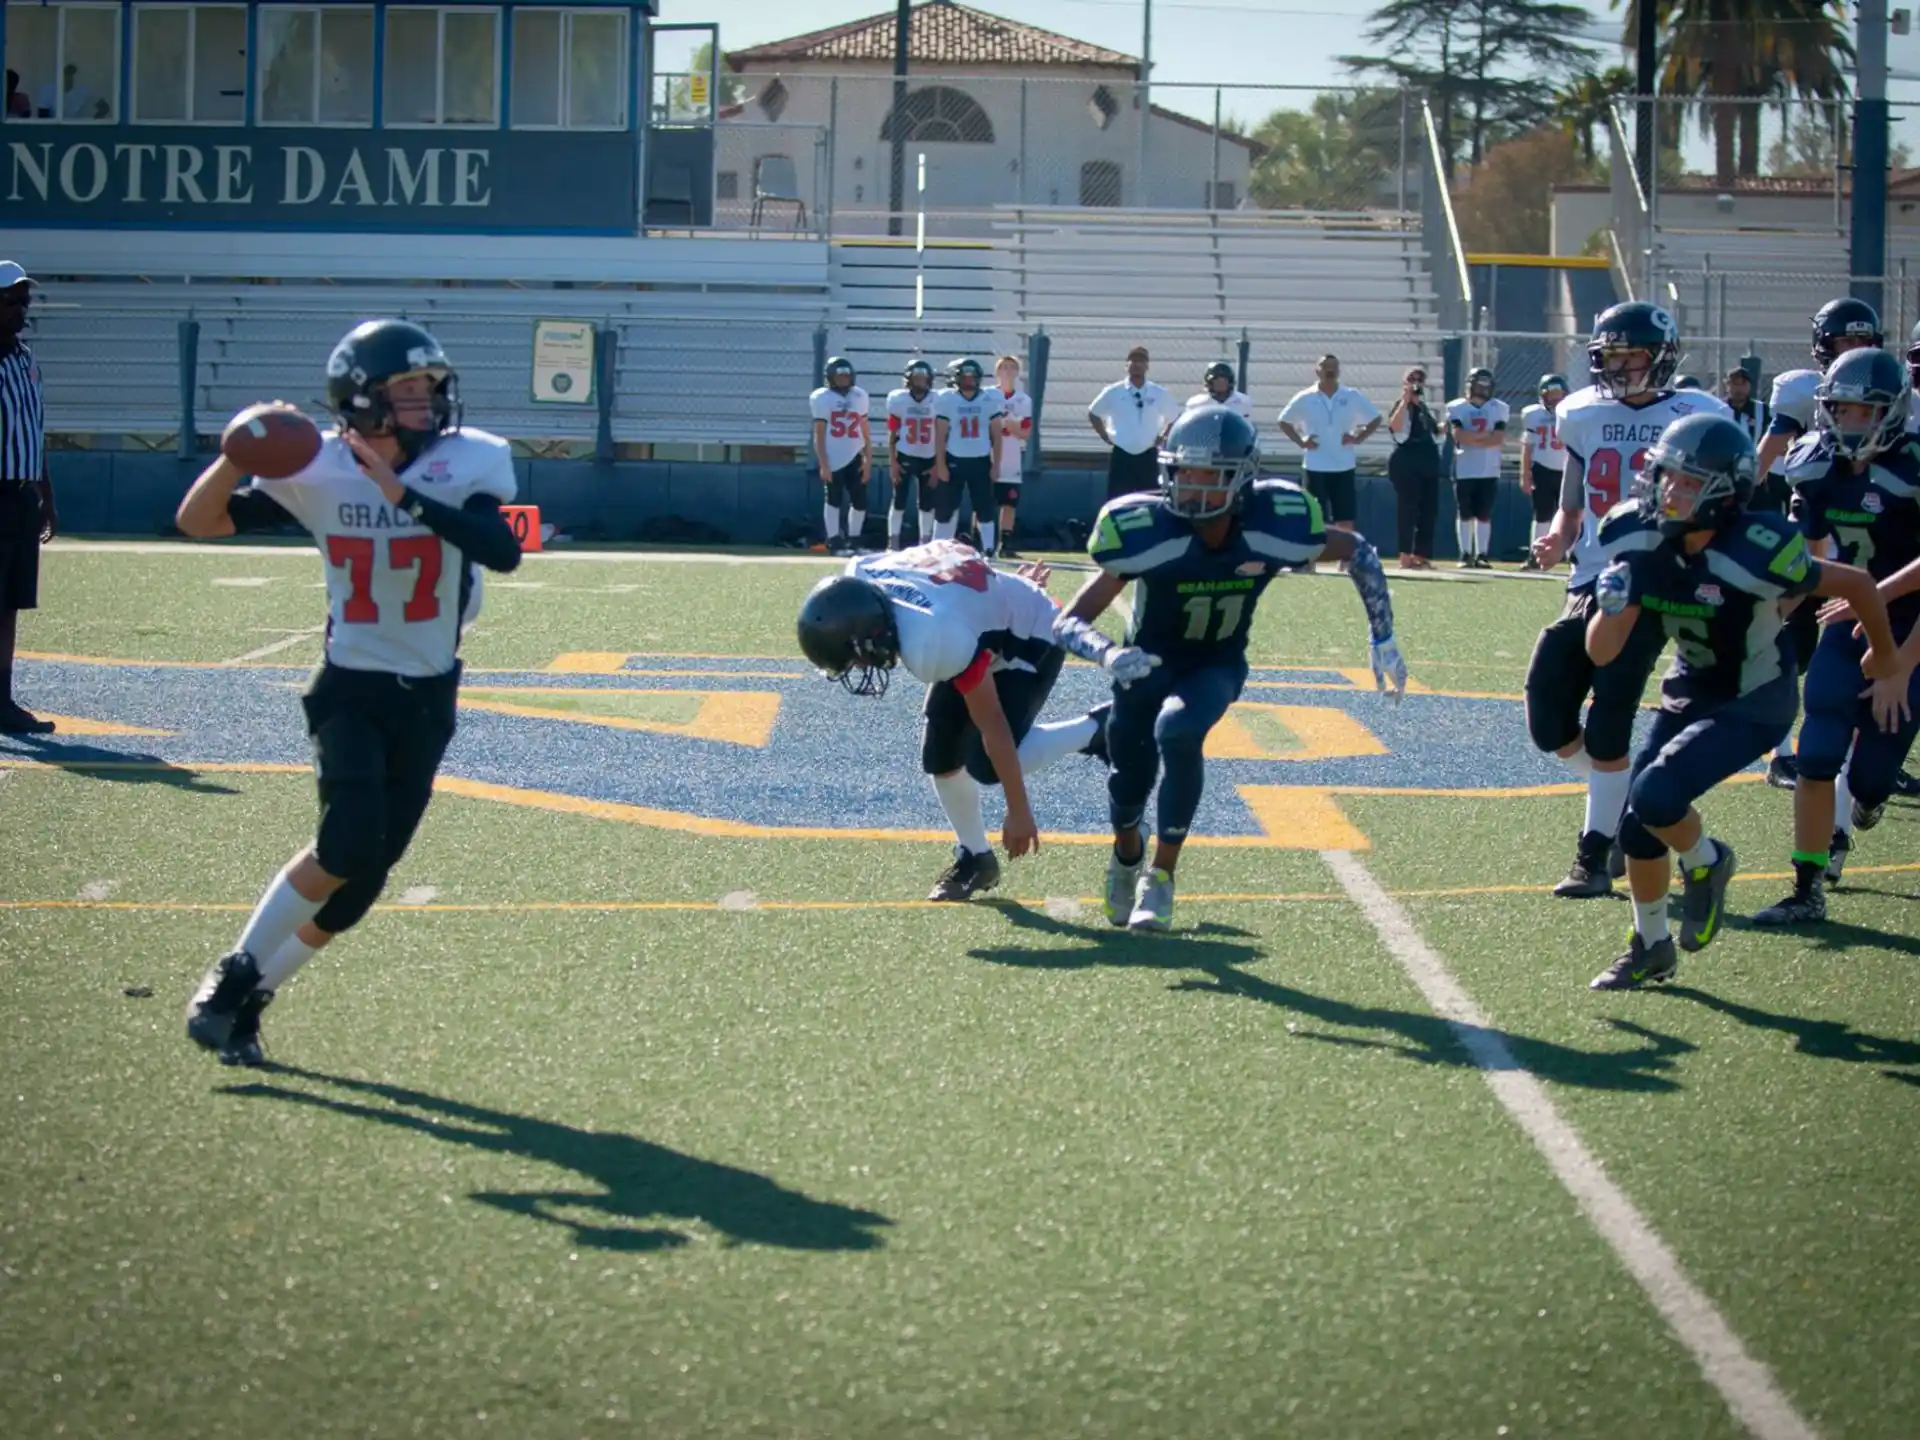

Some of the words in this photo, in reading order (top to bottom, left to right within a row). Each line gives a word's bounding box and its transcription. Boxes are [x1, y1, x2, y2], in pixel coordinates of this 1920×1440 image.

[7, 142, 254, 204] NOTRE
[278, 146, 492, 207] DAME
[830, 411, 860, 438] 52
[905, 417, 933, 445] 35
[961, 416, 980, 438] 11
[1602, 424, 1663, 442] GRACE
[338, 502, 421, 529] GRAC
[500, 511, 528, 543] 0
[1746, 523, 1782, 549] 6
[1835, 525, 1876, 573] 7
[325, 533, 442, 624] 77
[1176, 578, 1255, 594] SEAHAWKS
[1182, 594, 1247, 641] 11
